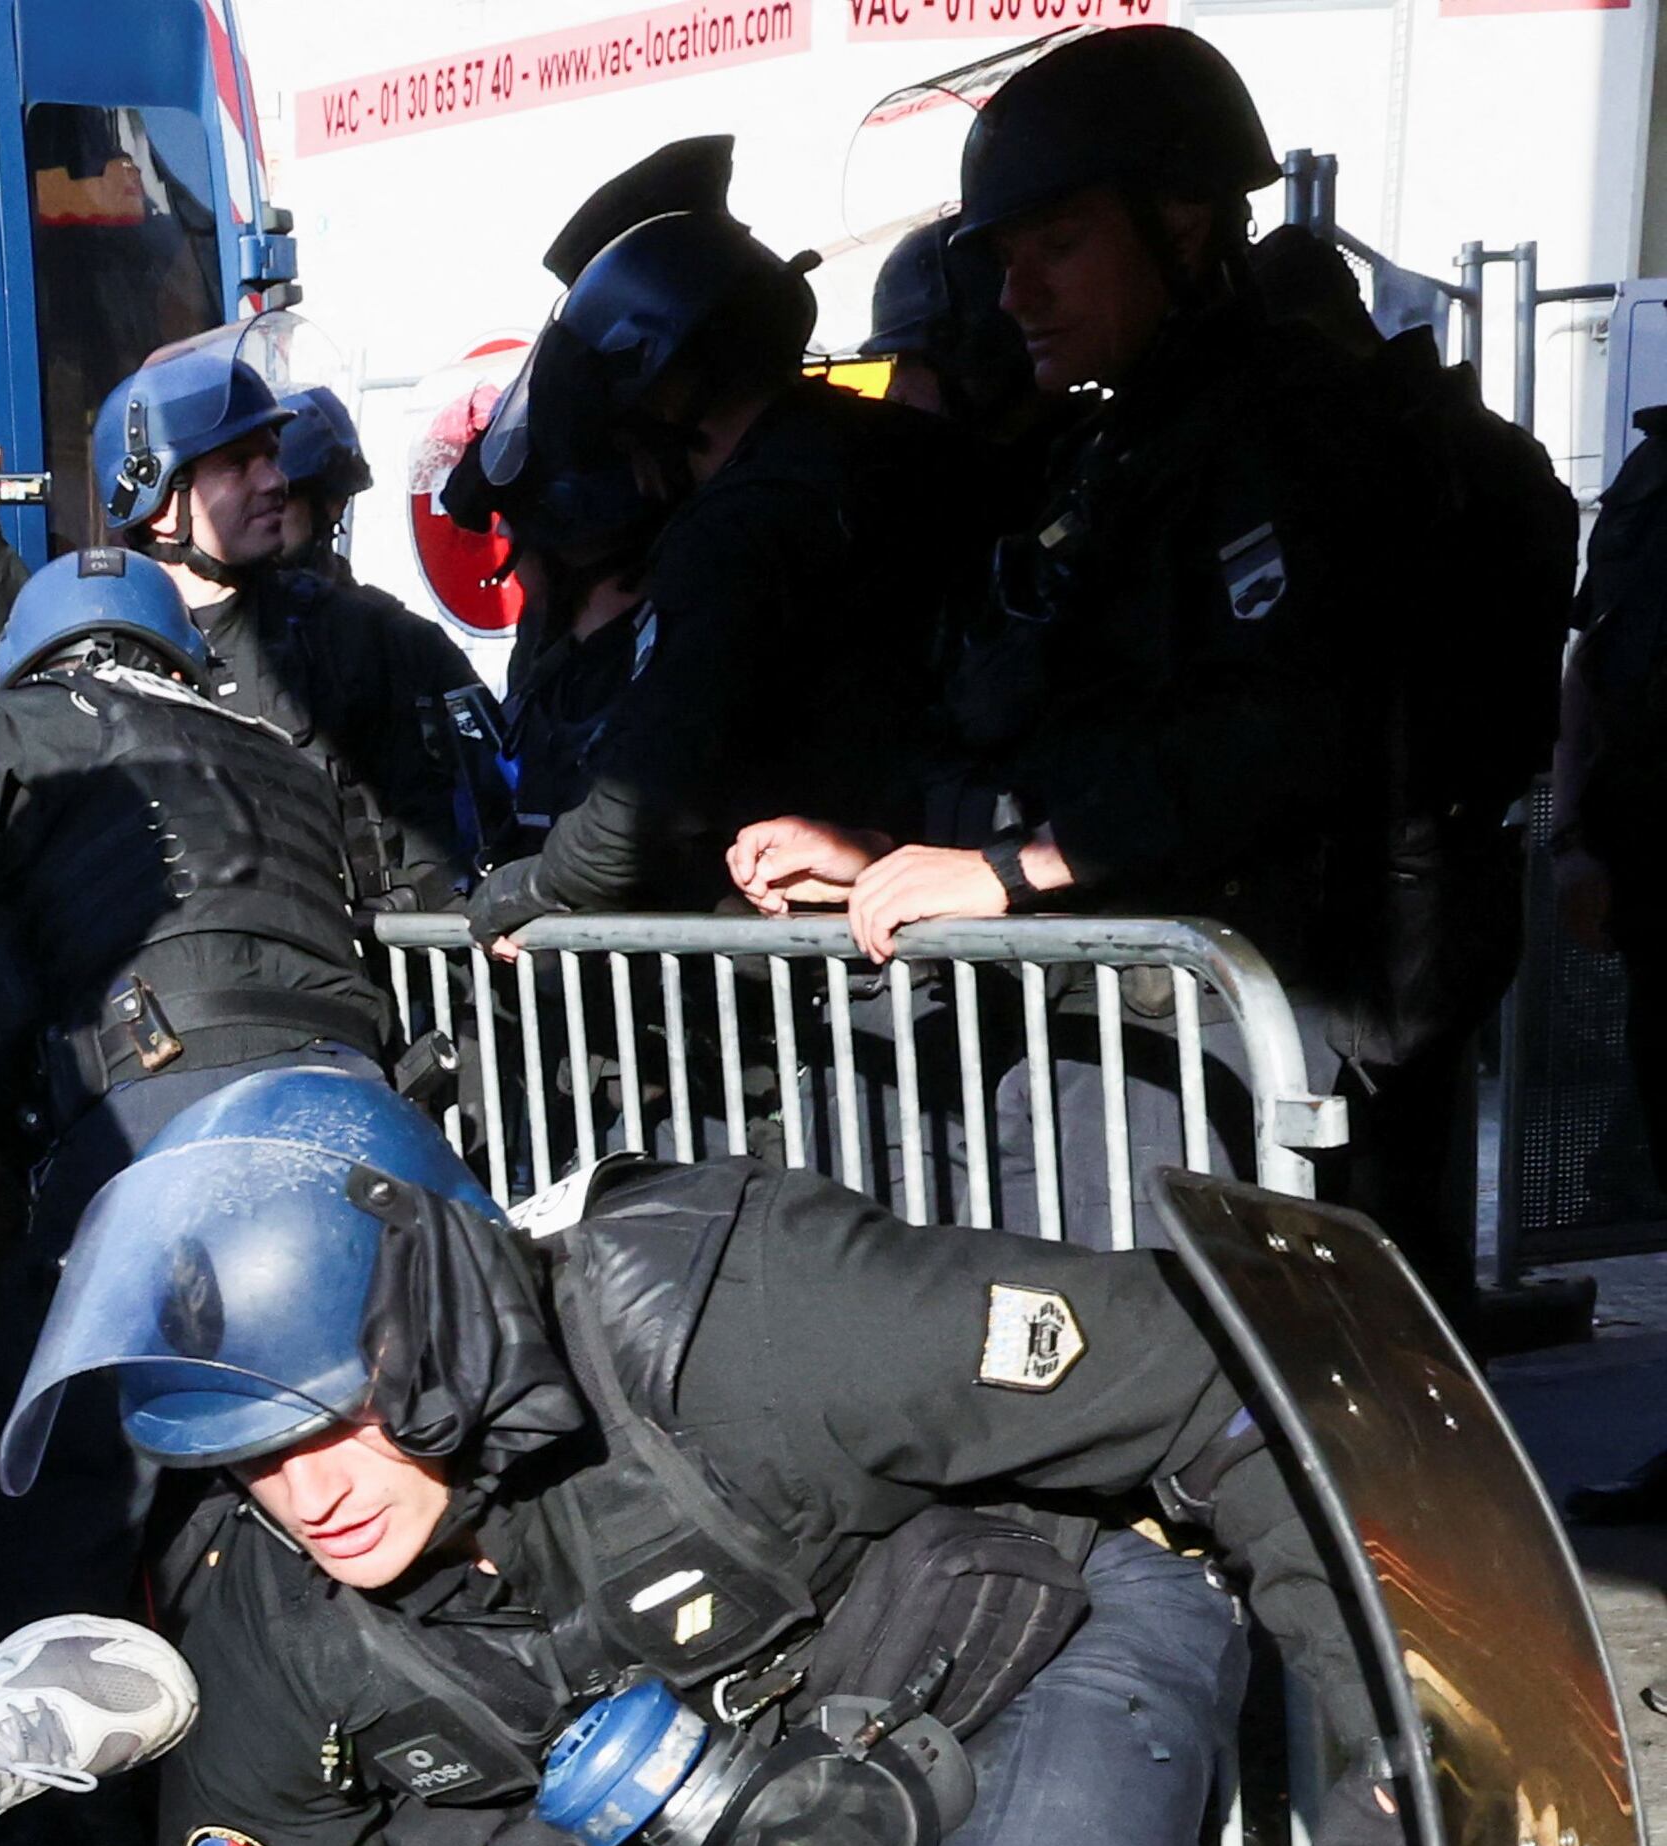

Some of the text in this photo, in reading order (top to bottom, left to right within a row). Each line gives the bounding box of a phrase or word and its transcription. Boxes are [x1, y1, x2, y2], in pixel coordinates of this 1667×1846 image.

[323, 88, 360, 138] VAC
[380, 80, 400, 126] 01
[407, 73, 428, 121] 30
[435, 66, 457, 114] 65
[463, 59, 485, 108] 57
[491, 52, 514, 102] 40
[537, 1, 793, 91] www.vac-location.com
